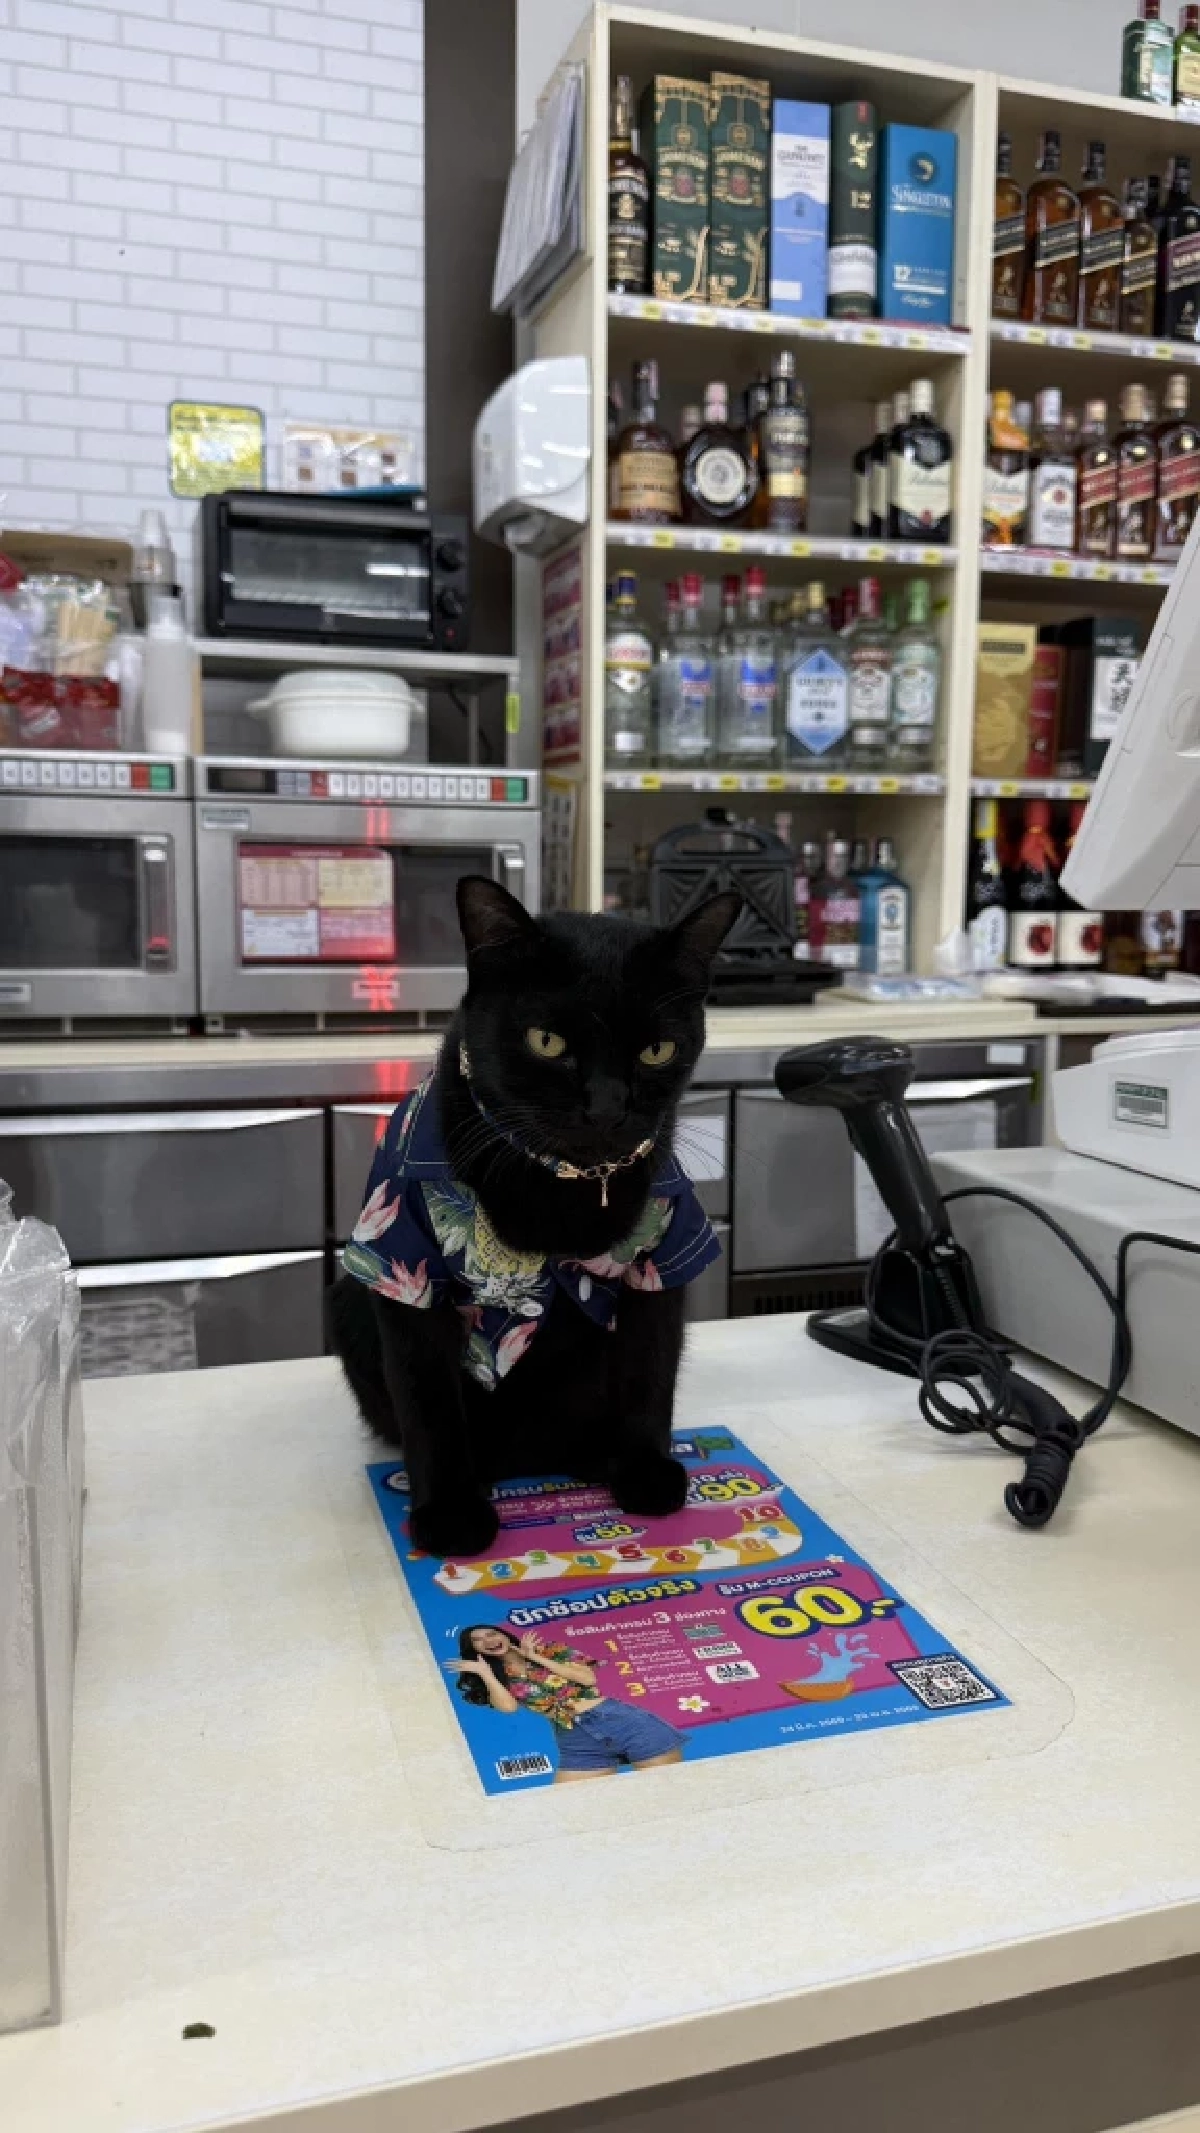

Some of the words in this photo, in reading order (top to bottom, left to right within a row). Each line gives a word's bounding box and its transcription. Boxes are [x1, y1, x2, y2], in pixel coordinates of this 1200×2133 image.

[617, 1543, 643, 1560] 5
[745, 1568, 834, 1590] M-COUPON
[653, 1611, 671, 1624] 3
[604, 1638, 620, 1653] 1
[615, 1660, 634, 1676] 2
[626, 1681, 647, 1697] 3
